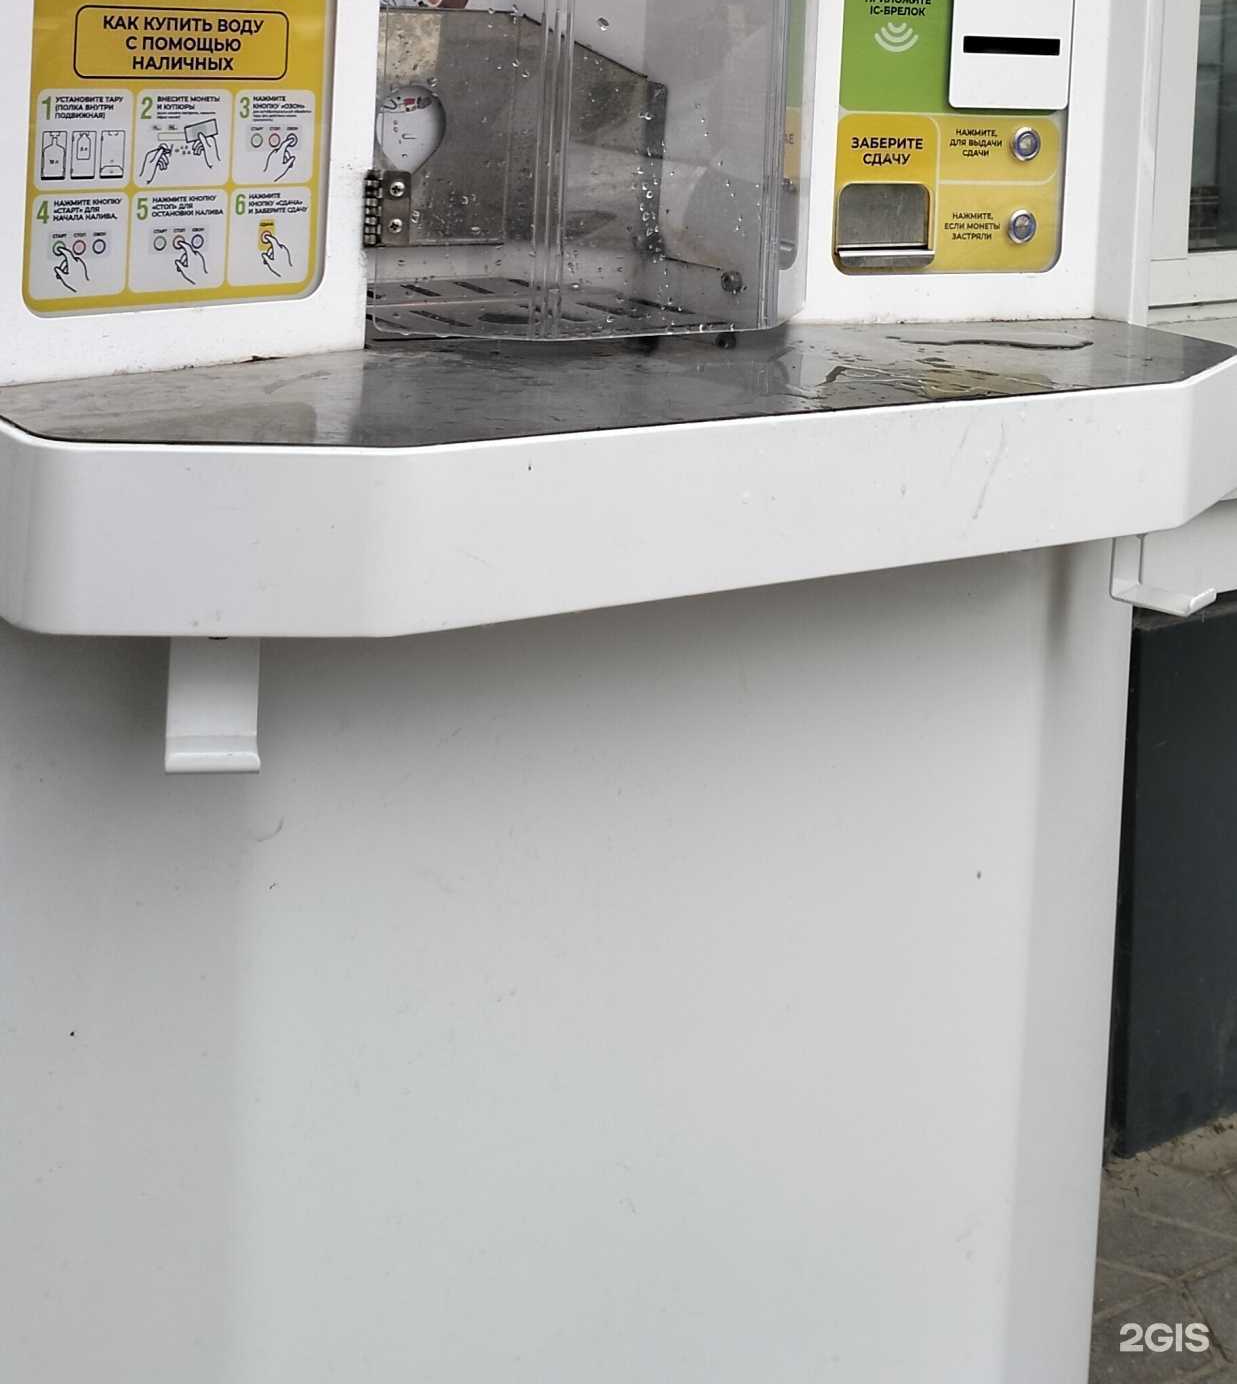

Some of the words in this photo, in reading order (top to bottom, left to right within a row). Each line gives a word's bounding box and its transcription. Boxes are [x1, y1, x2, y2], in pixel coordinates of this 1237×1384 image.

[103, 15, 139, 31] КАК
[144, 16, 213, 32] КУПИТЬ
[218, 19, 264, 35] ВОДУ
[126, 36, 138, 50] С
[142, 36, 242, 54] ПОМОЩЬЮ
[132, 56, 234, 72] НАЛИЧНЫХ
[42, 96, 52, 120] 1
[141, 96, 153, 120] 2
[163, 103, 195, 111] КУПЮРЫ
[239, 97, 250, 119] 3
[955, 128, 998, 137] НАЖМИТЕ,
[851, 136, 923, 150] ЗАБЕРИТЕ
[950, 138, 966, 147] ДЛЯ
[968, 139, 1002, 148] ВЫДАЧИ
[962, 148, 989, 157] СДАЧИ
[863, 154, 911, 166] СДАЧУ
[92, 198, 122, 206] КНОПКУ
[136, 198, 148, 220] 5
[235, 194, 246, 215] 6
[36, 200, 49, 224] 4
[952, 212, 994, 221] НАЖМИТЕ,
[944, 222, 965, 230] ЕСЛИ
[966, 222, 1000, 230] МОНЕТЫ
[952, 232, 992, 240] ЗАСТРЯЛИ
